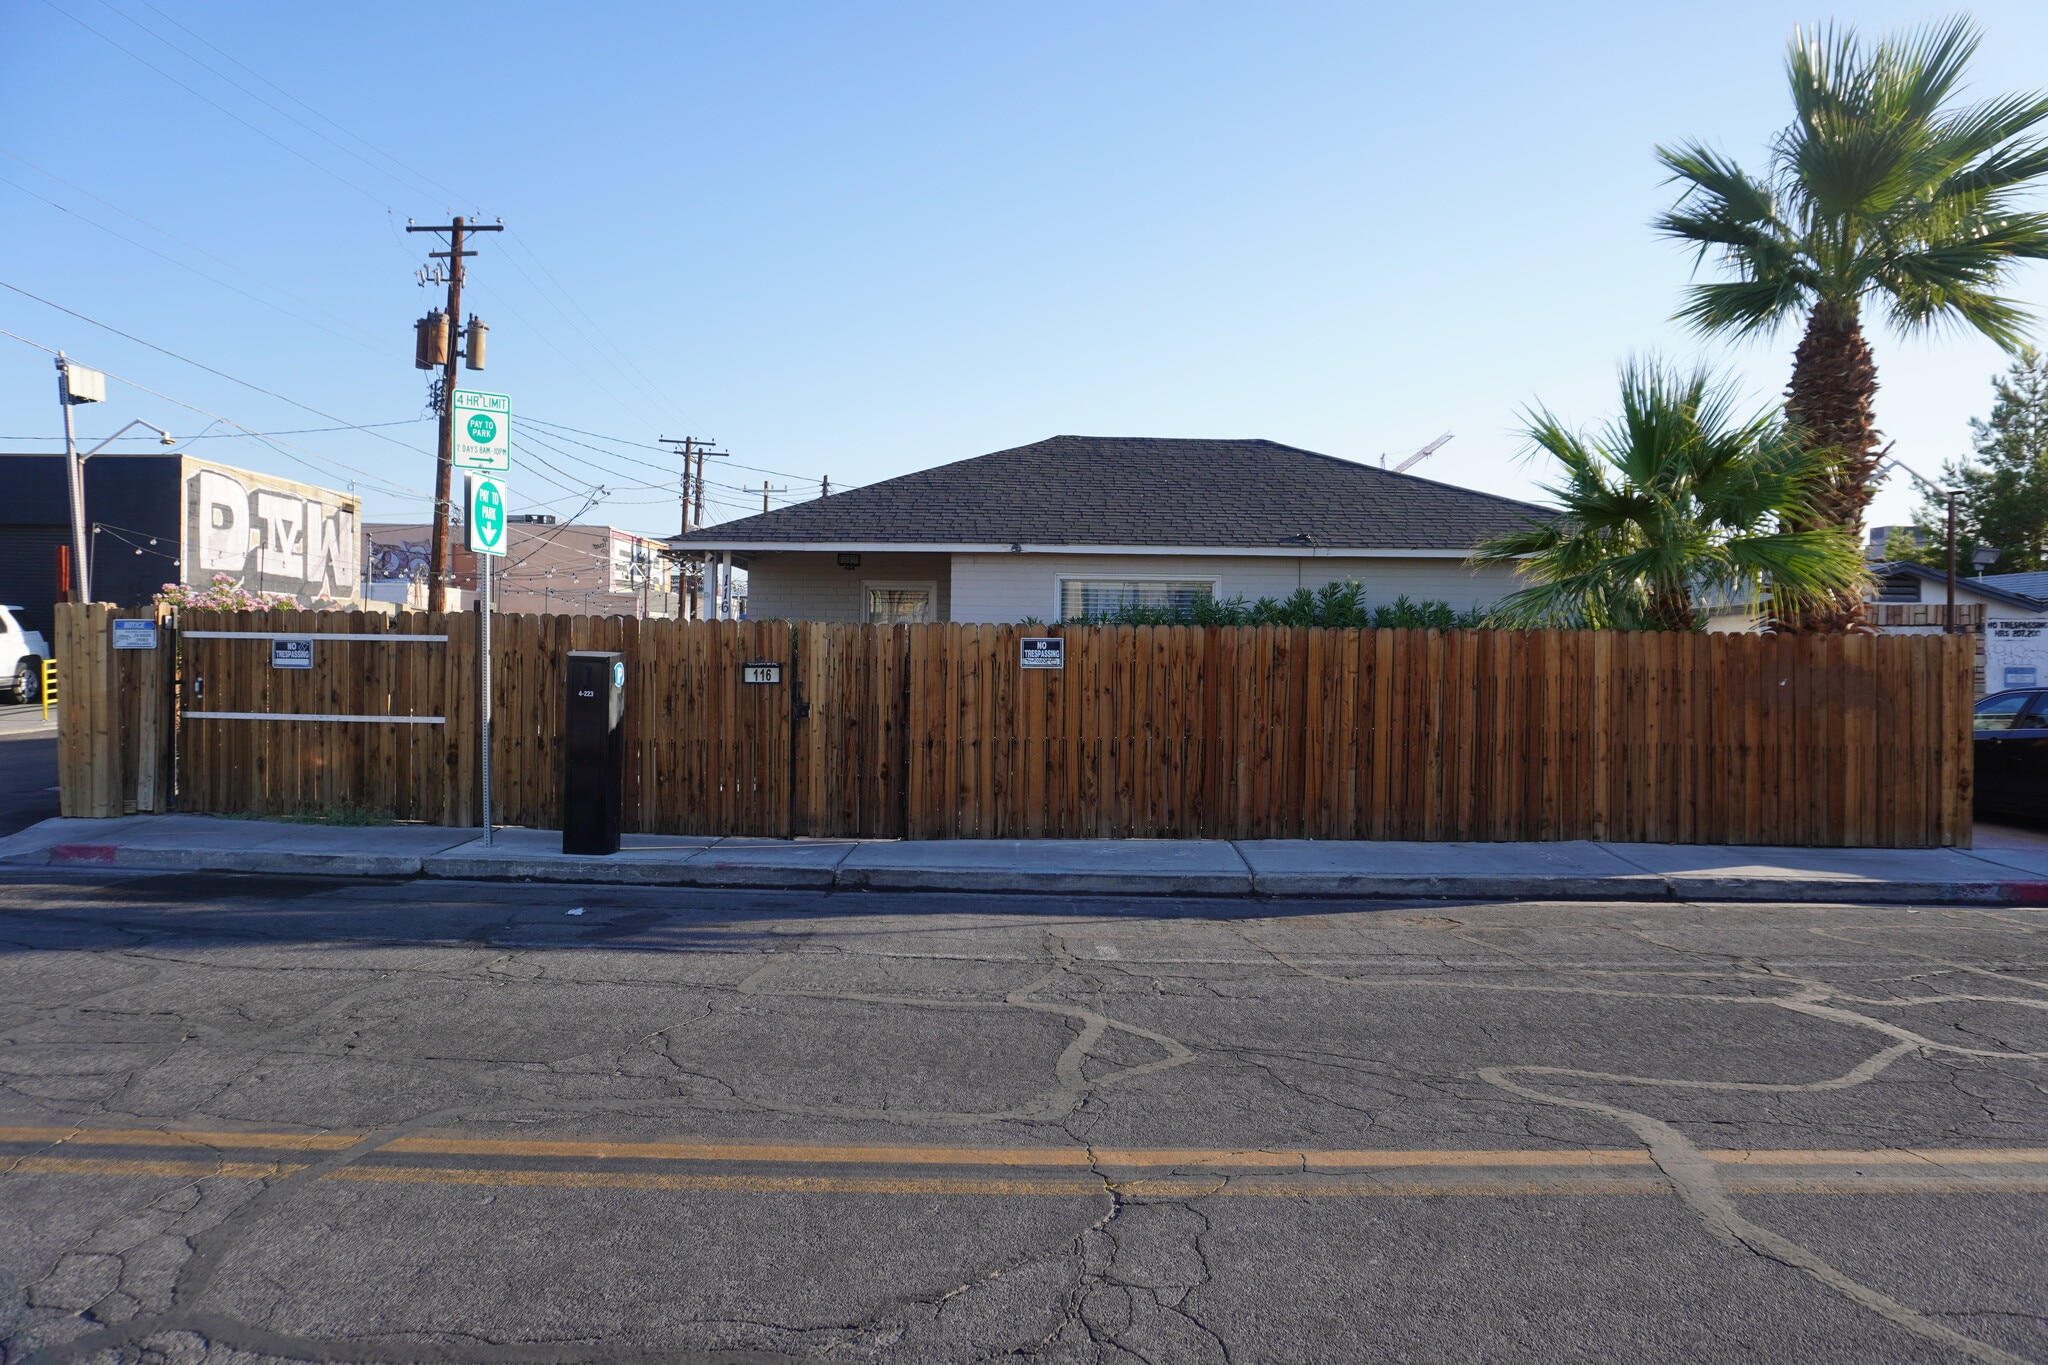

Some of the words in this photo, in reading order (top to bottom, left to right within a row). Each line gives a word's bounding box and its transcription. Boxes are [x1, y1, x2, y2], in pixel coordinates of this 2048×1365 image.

[457, 394, 464, 405] 4
[467, 396, 480, 407] HR
[483, 397, 507, 410] LIMIT
[470, 420, 483, 429] PAY
[485, 421, 494, 430] TO
[473, 429, 491, 438] PARK
[457, 444, 461, 452] 7
[462, 444, 479, 453] DAYS
[480, 489, 489, 502] PAY
[492, 491, 499, 506] TO
[482, 506, 497, 521] PARK
[287, 642, 297, 650] NO
[275, 650, 309, 658] TRESPASSING
[753, 668, 772, 682] 116
